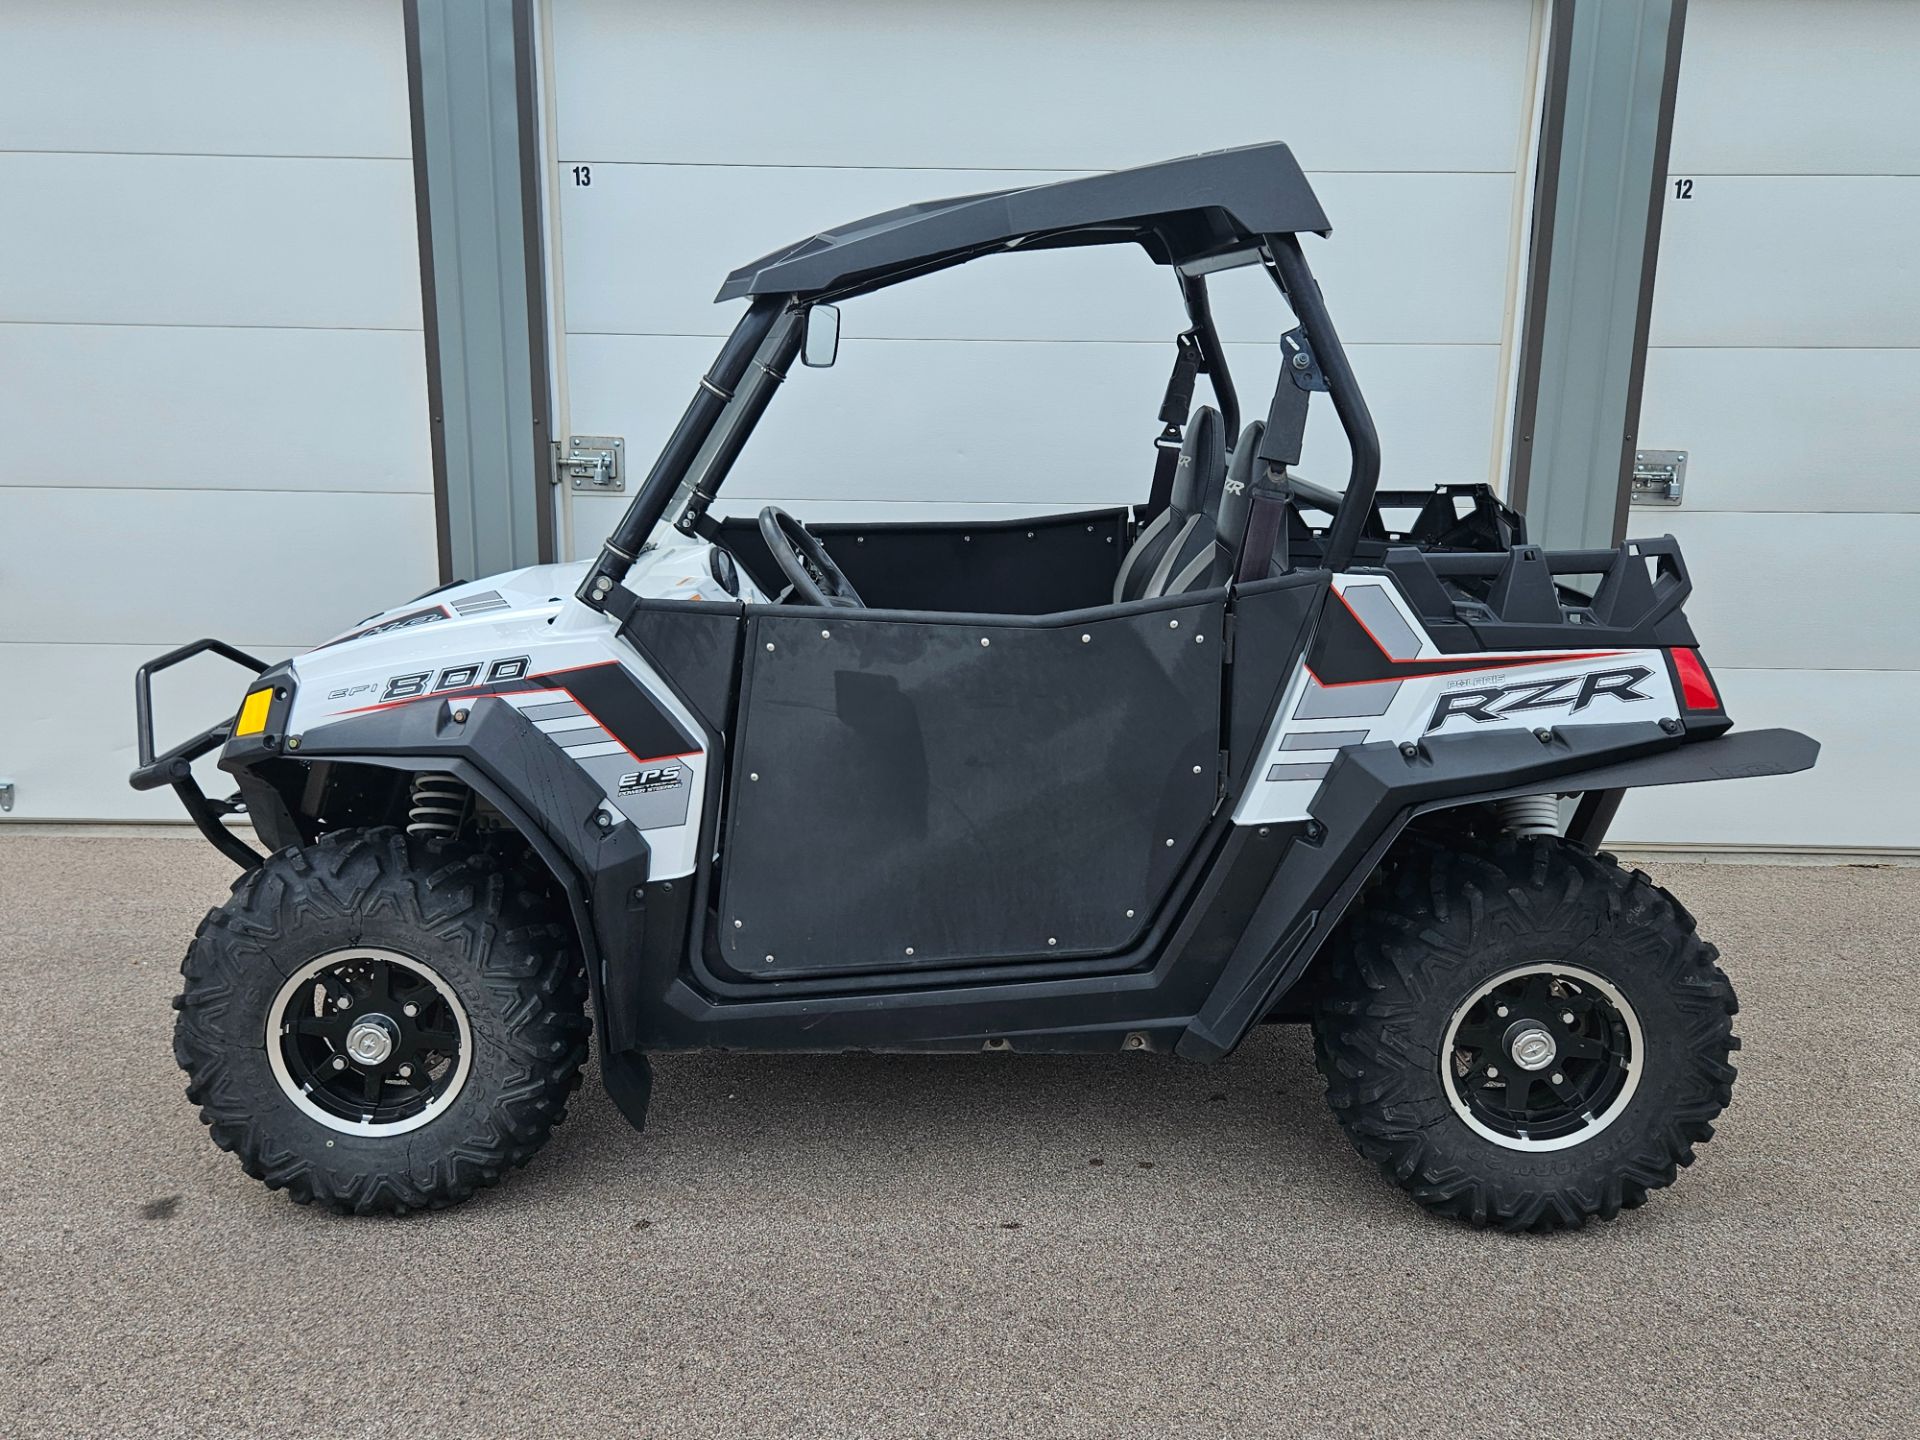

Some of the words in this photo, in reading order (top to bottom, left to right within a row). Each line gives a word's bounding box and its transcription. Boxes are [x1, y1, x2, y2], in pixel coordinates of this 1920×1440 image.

[572, 166, 591, 187] 13
[1674, 179, 1693, 199] 12
[1224, 478, 1245, 496] ZR
[327, 683, 378, 700] EFI
[379, 655, 532, 703] 800
[1447, 673, 1506, 689] POLARIS
[1422, 664, 1657, 737] RZR
[618, 765, 682, 787] EPS
[618, 787, 646, 798] POWER
[647, 782, 683, 794] STEERING
